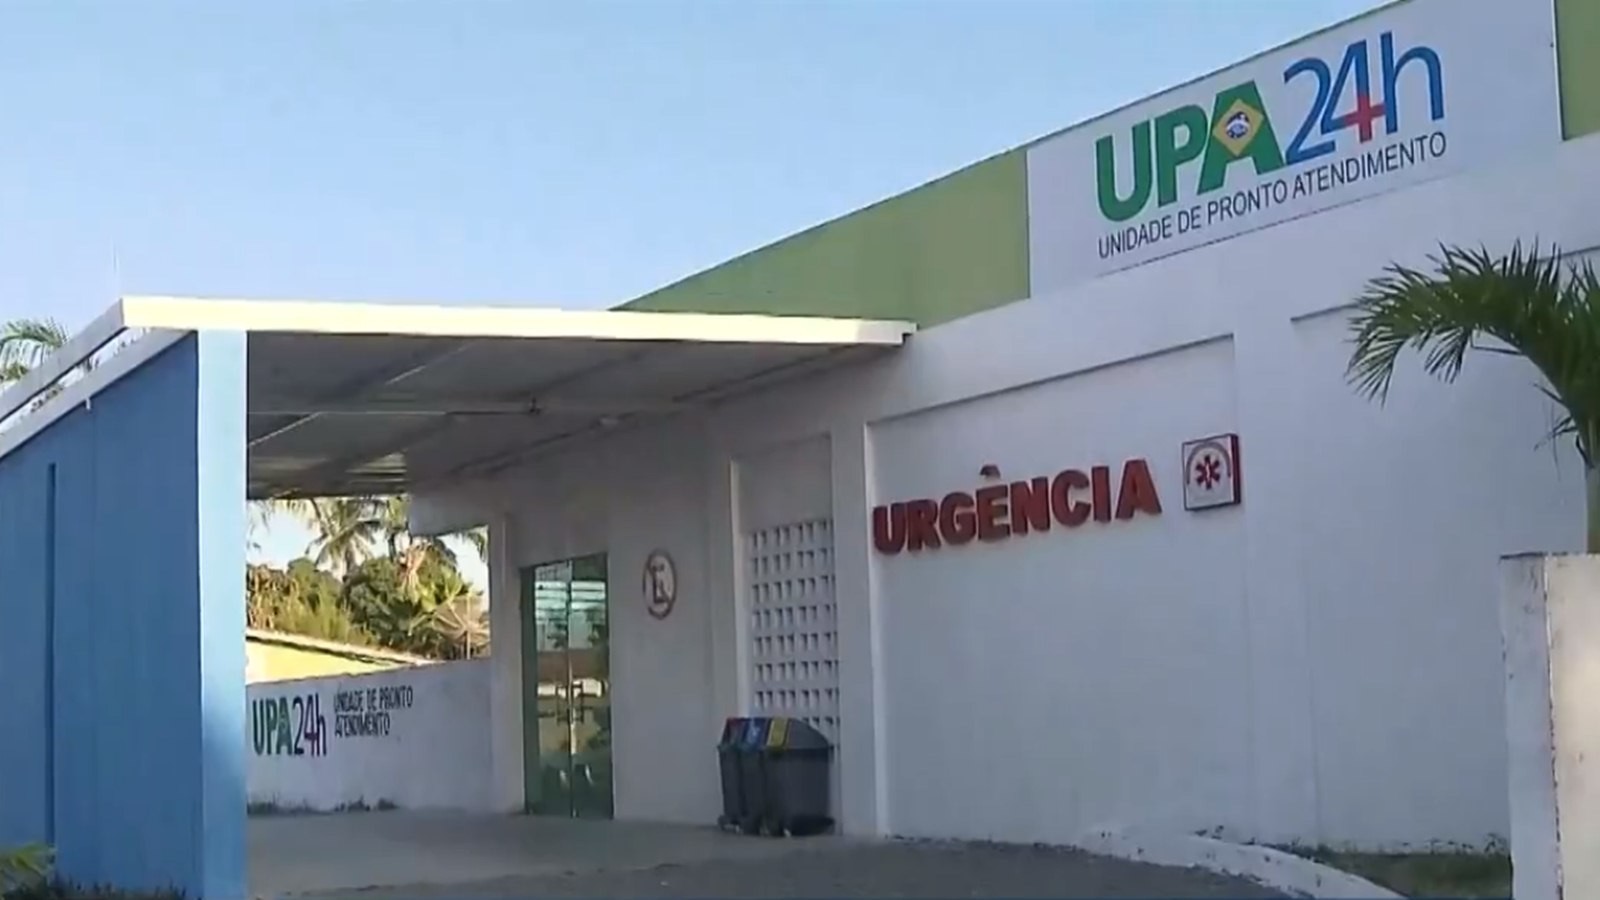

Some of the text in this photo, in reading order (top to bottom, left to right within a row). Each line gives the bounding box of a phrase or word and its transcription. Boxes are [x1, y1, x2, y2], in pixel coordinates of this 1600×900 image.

[1098, 131, 1447, 259] UNIDADE DE PRONTO ATENDIMENTO
[873, 457, 1163, 556] URGÊNCIA
